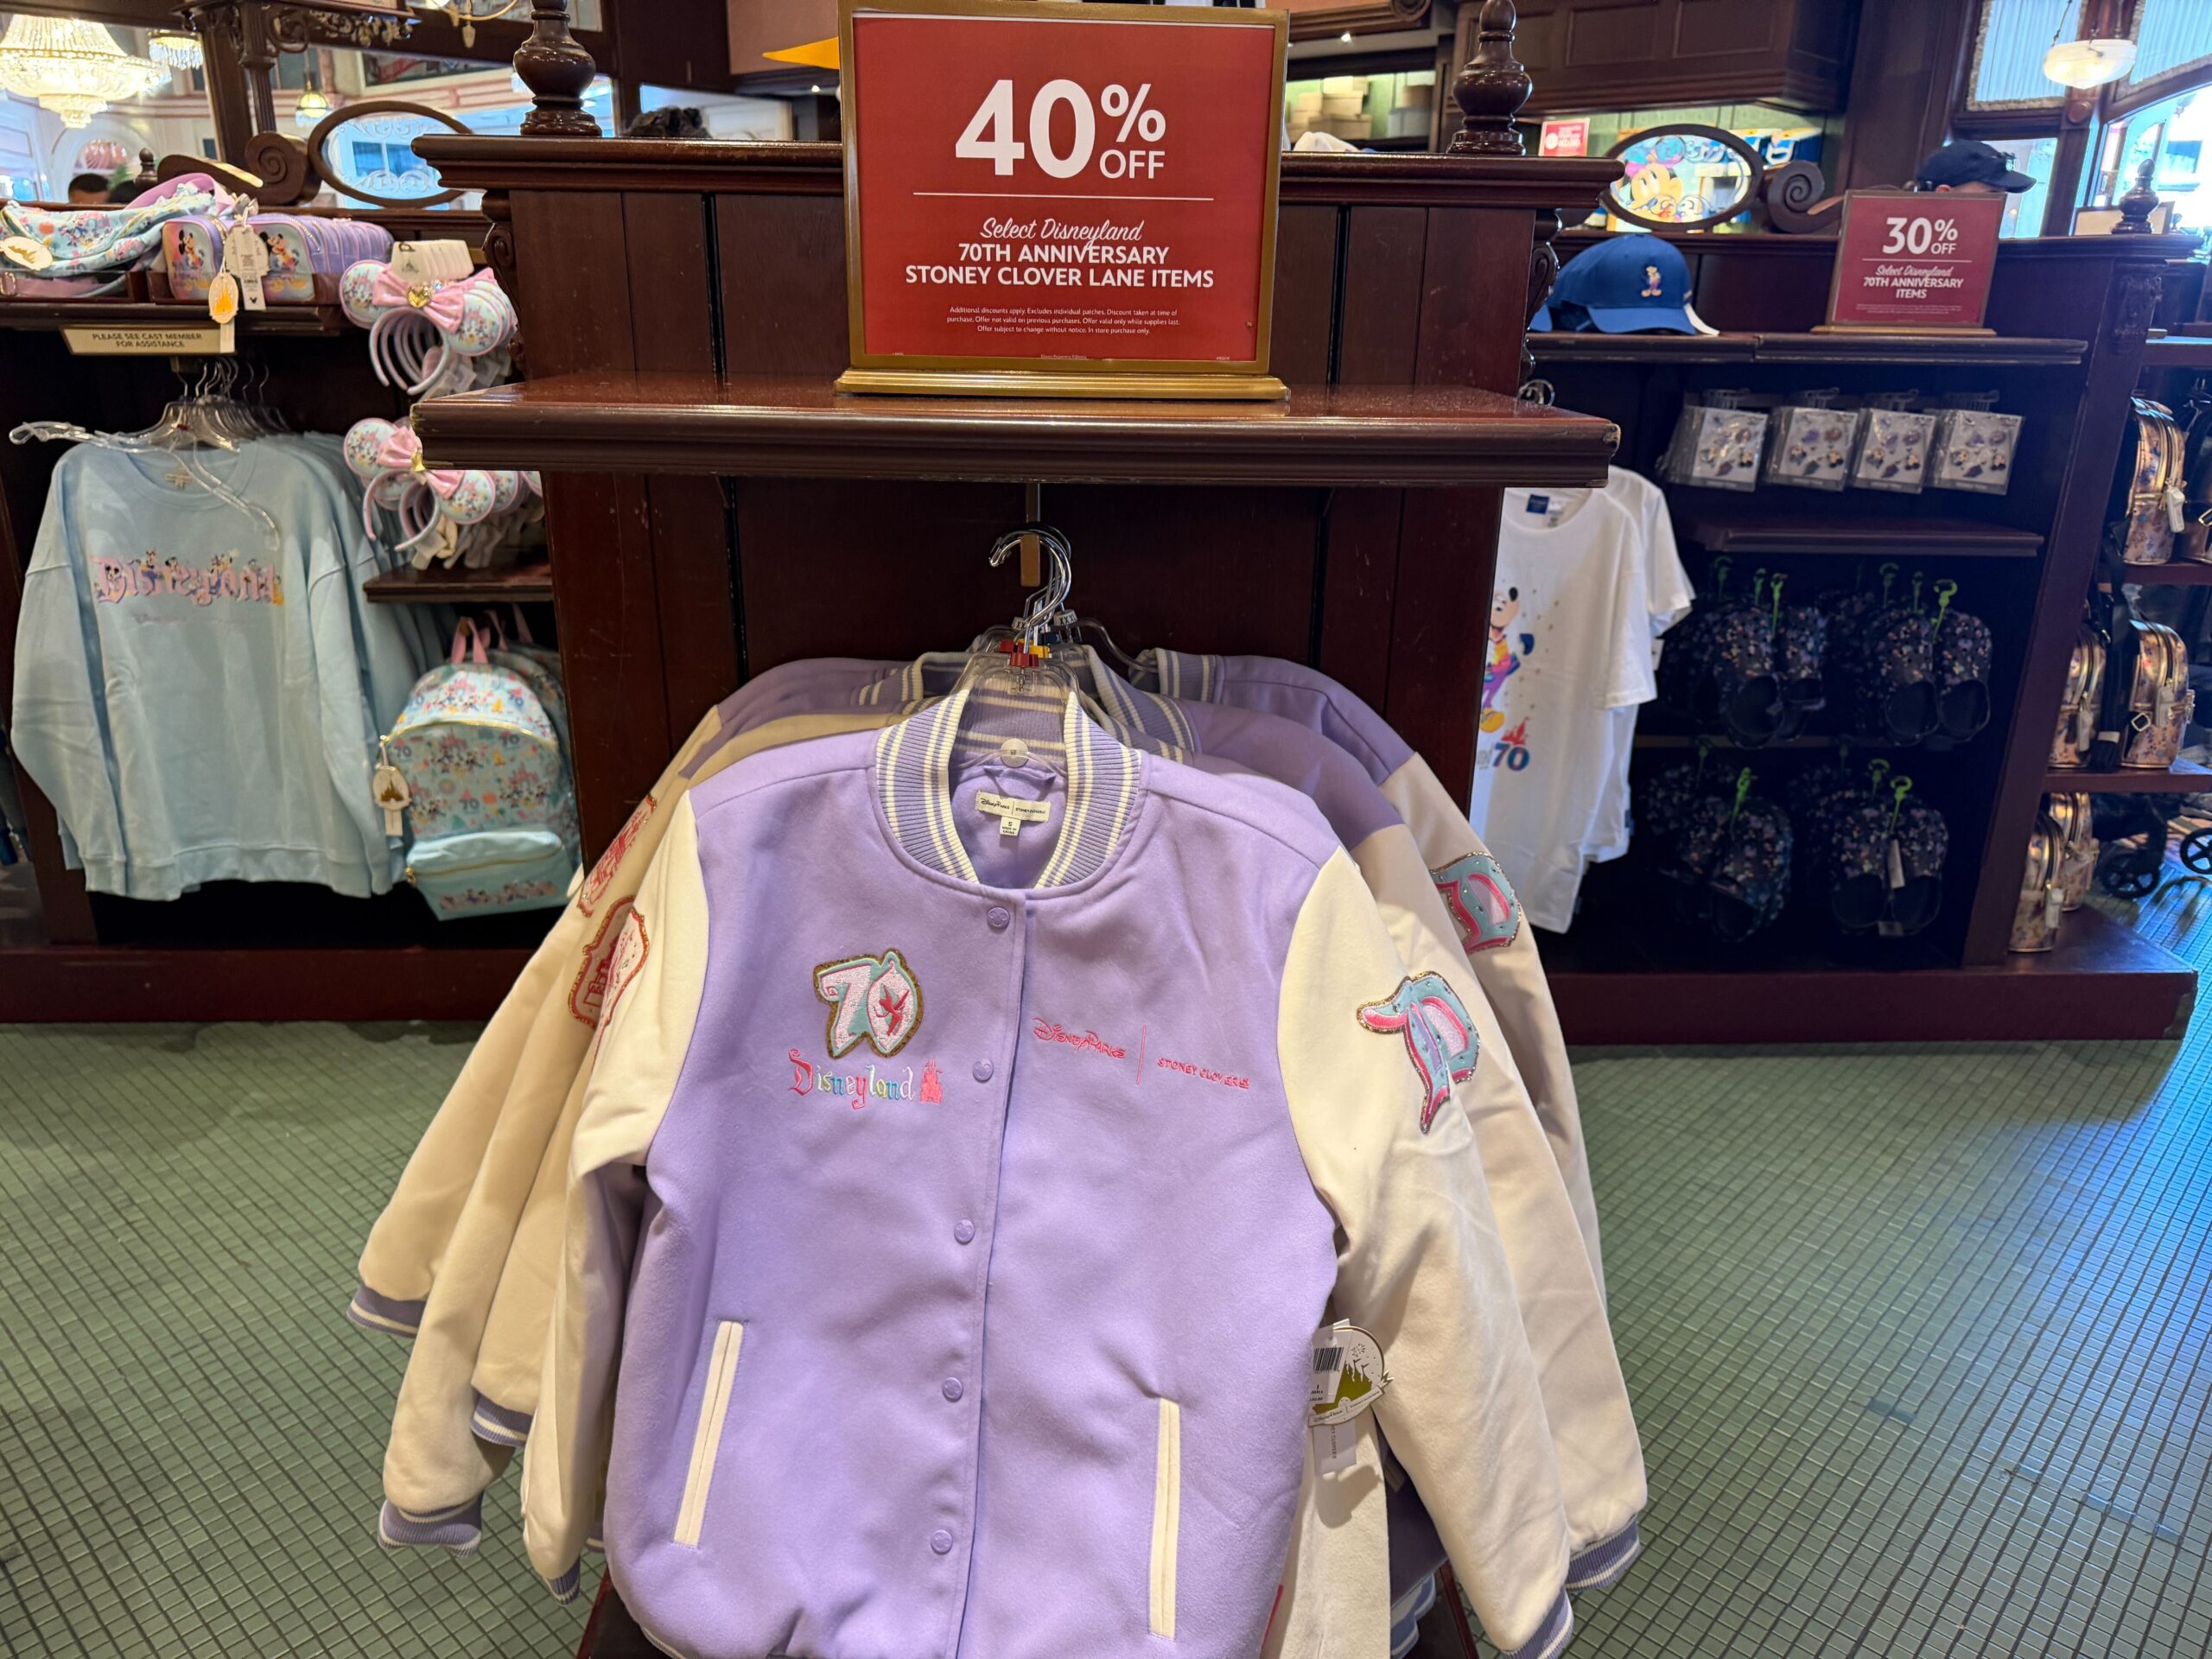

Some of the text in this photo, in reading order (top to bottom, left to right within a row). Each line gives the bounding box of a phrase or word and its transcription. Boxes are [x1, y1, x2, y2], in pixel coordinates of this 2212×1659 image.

[955, 79, 1166, 179] 40% OFF
[980, 217, 1145, 250] Select Disneyland
[1882, 217, 1959, 255] 30% OFF
[958, 243, 1170, 264] 70TH ANNIVERSARY
[906, 264, 1214, 288] STONEY CLOVER LANE ITEMS
[1863, 276, 1964, 289] 70TH ANNIVERSARY
[1875, 264, 1955, 280] Select Disneyland
[1896, 289, 1928, 299] ITEMS
[1492, 741, 1530, 772] 70
[817, 953, 920, 1056] 70
[787, 1047, 917, 1110] Disneyland
[1157, 1057, 1198, 1077] STONEY
[1199, 1068, 1239, 1088] CLOVER
